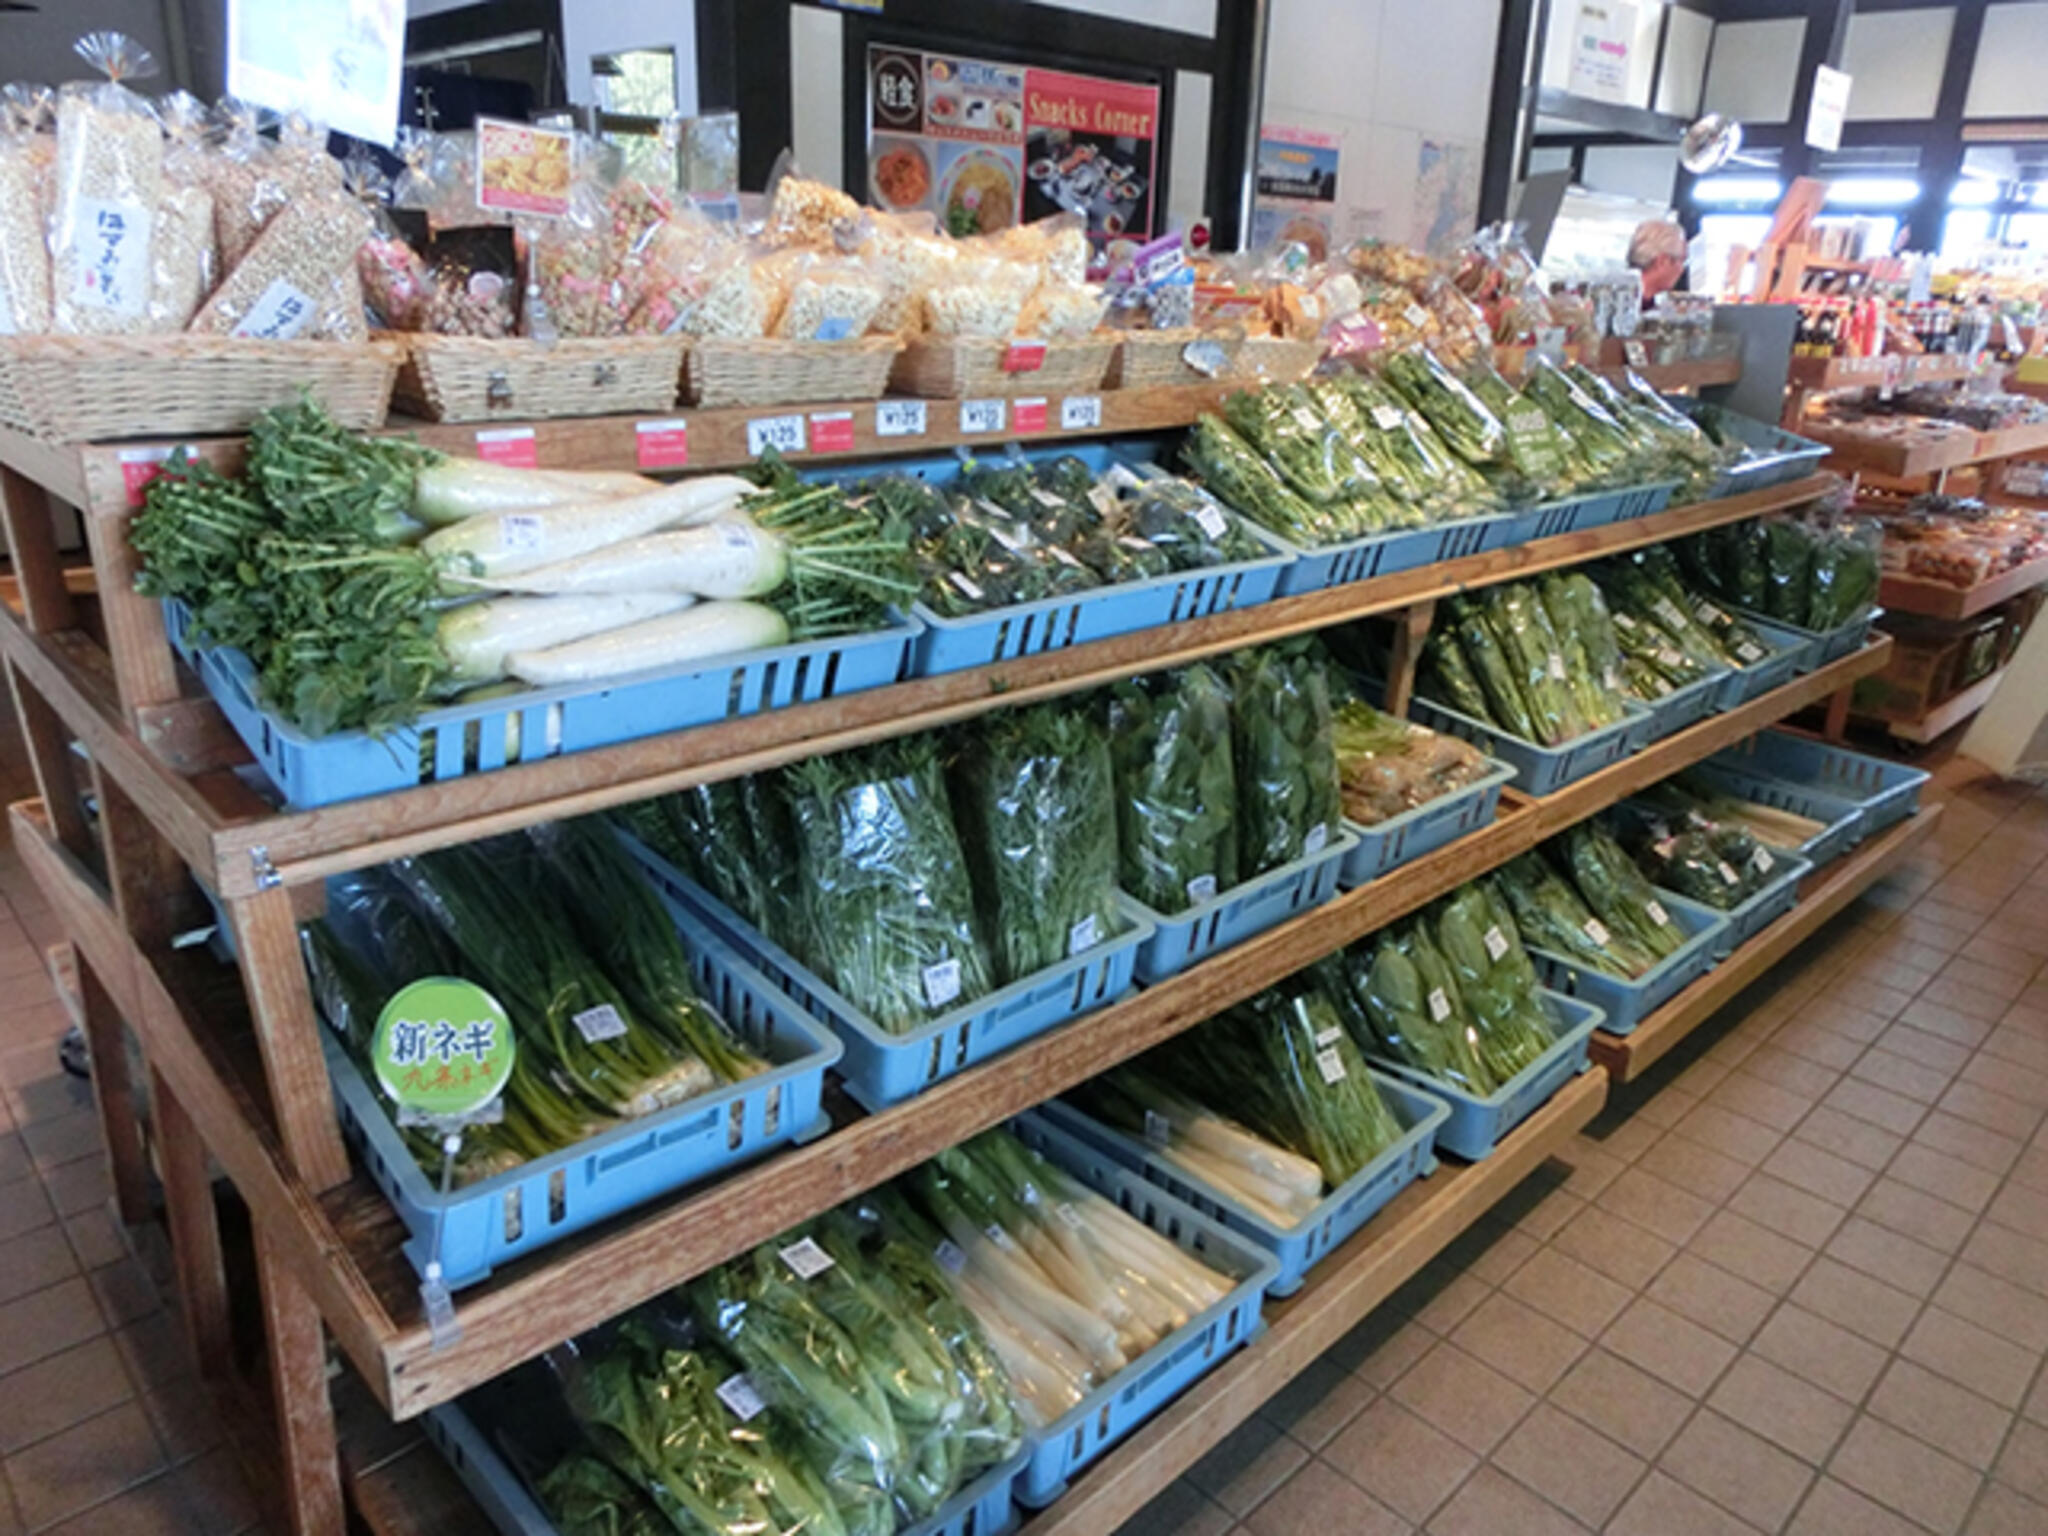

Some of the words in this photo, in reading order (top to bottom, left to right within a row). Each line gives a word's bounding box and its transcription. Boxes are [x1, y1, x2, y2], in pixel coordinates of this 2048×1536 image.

[880, 72, 914, 107] 軽食
[1029, 92, 1088, 127] Snacks
[1094, 101, 1152, 136] Corner
[391, 1020, 496, 1063] 新ネギ
